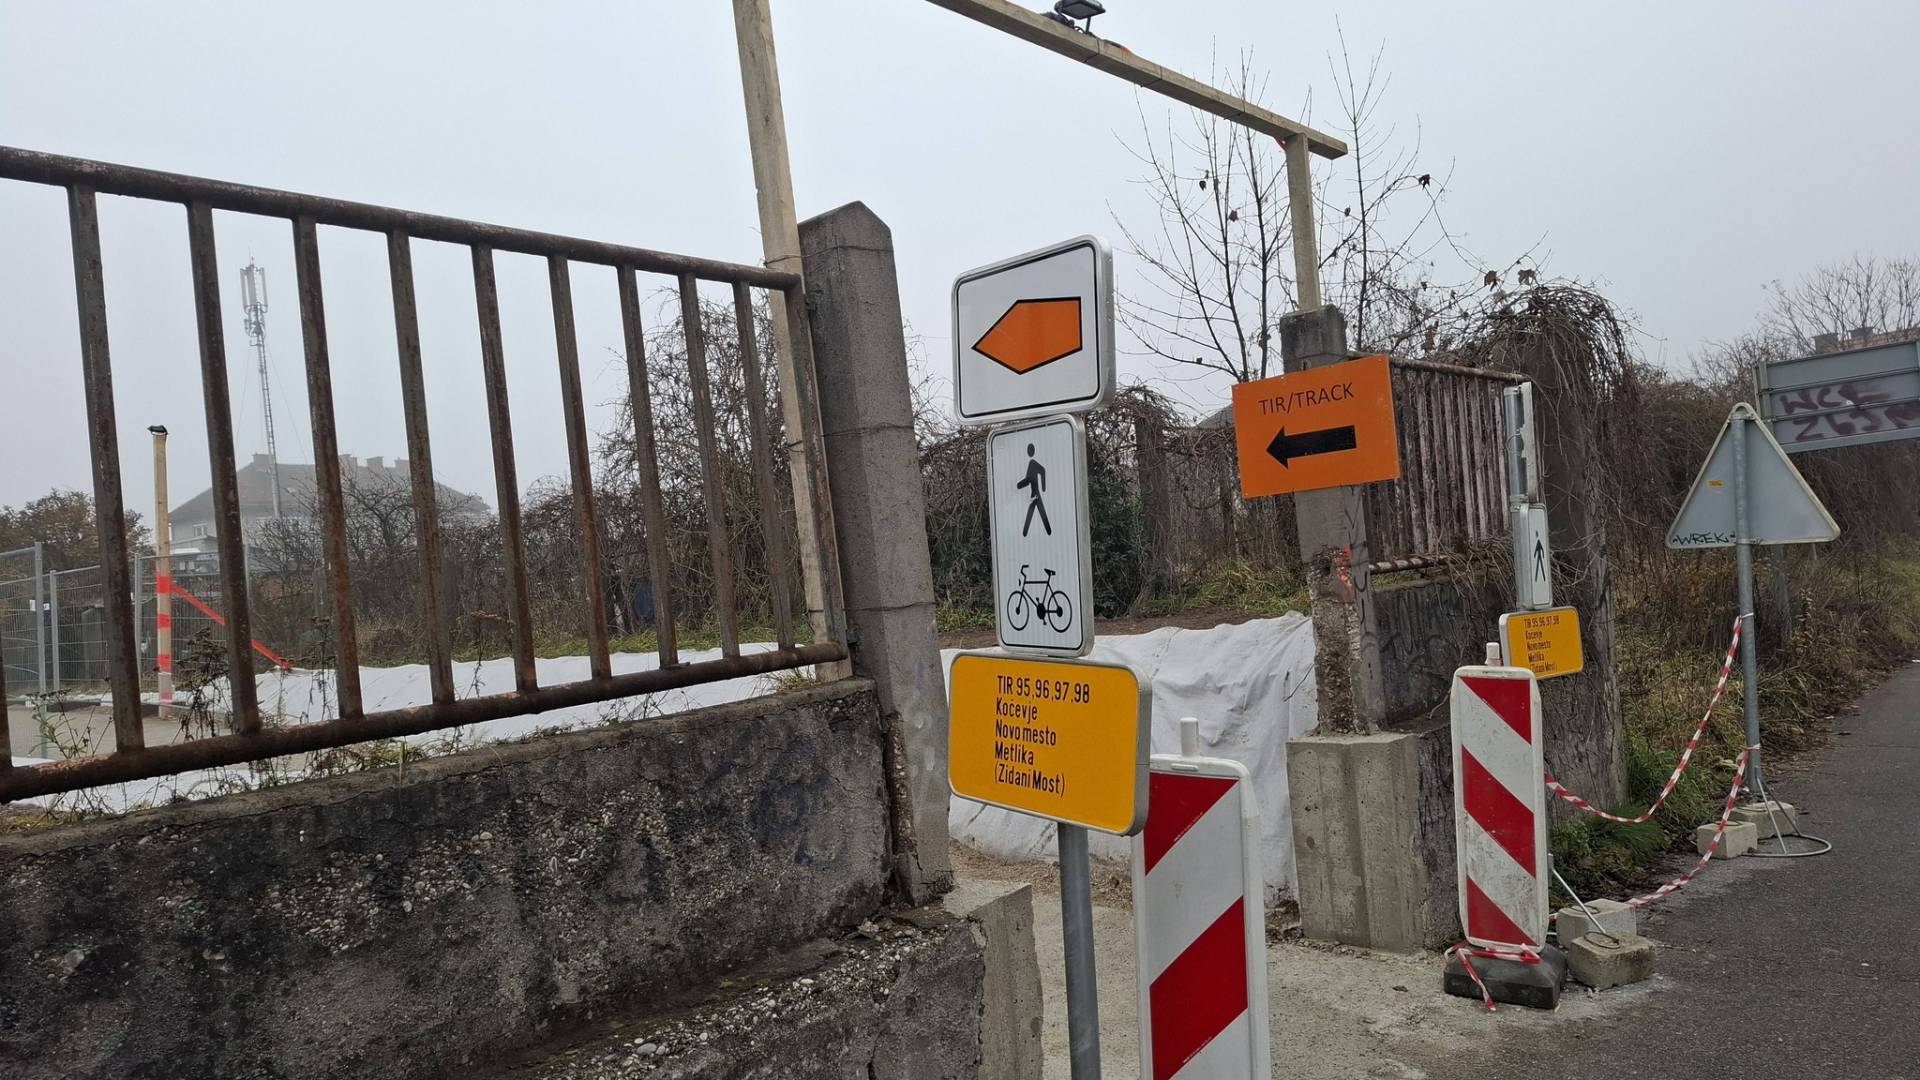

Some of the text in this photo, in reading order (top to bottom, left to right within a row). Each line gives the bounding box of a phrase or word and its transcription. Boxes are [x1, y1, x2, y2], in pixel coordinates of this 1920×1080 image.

[1258, 382, 1355, 415] TIR/TRACK
[997, 675, 1013, 695] TIR
[996, 719, 1056, 746] Novo mesto
[995, 741, 1034, 765] Metlika
[995, 761, 1065, 798] (Zidani Most)
